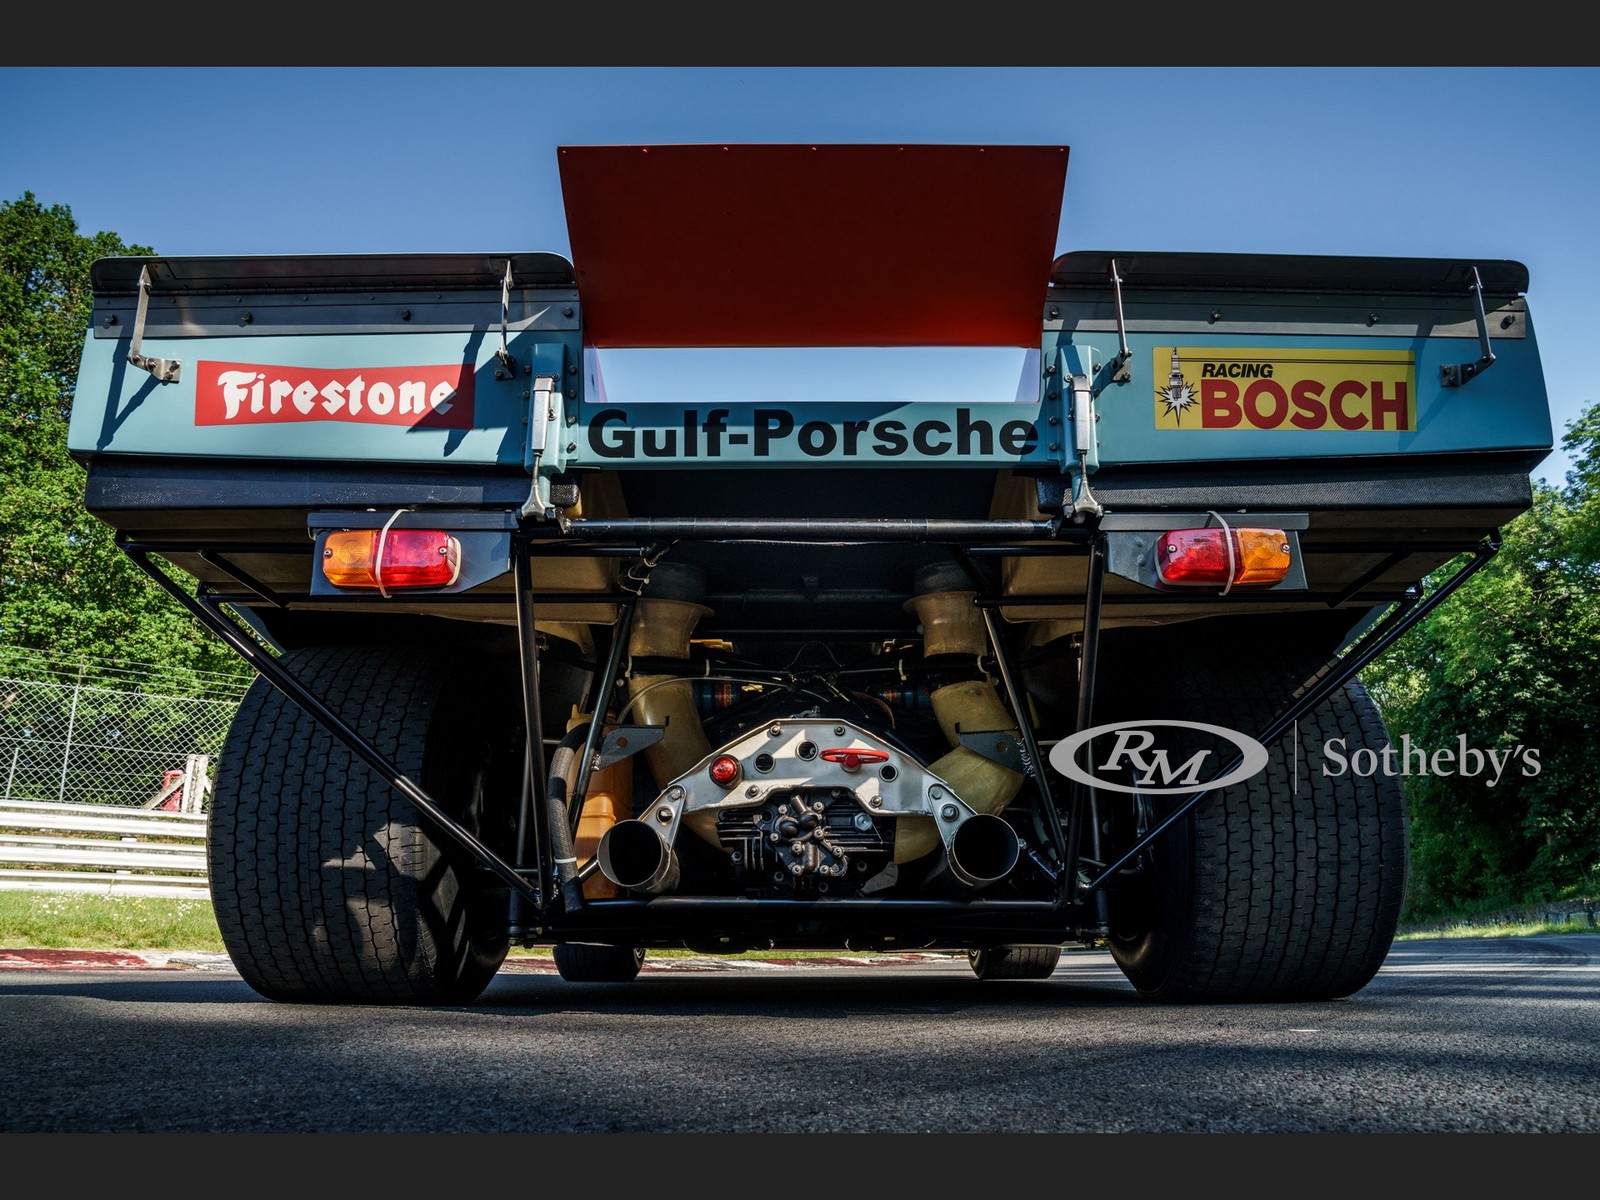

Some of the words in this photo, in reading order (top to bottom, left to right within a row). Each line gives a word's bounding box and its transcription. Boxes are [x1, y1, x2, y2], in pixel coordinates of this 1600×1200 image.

[217, 371, 456, 419] Firestone
[1202, 363, 1273, 378] RACING
[1201, 379, 1409, 430] BOSCH
[587, 408, 1038, 458] Gulf-Porsche
